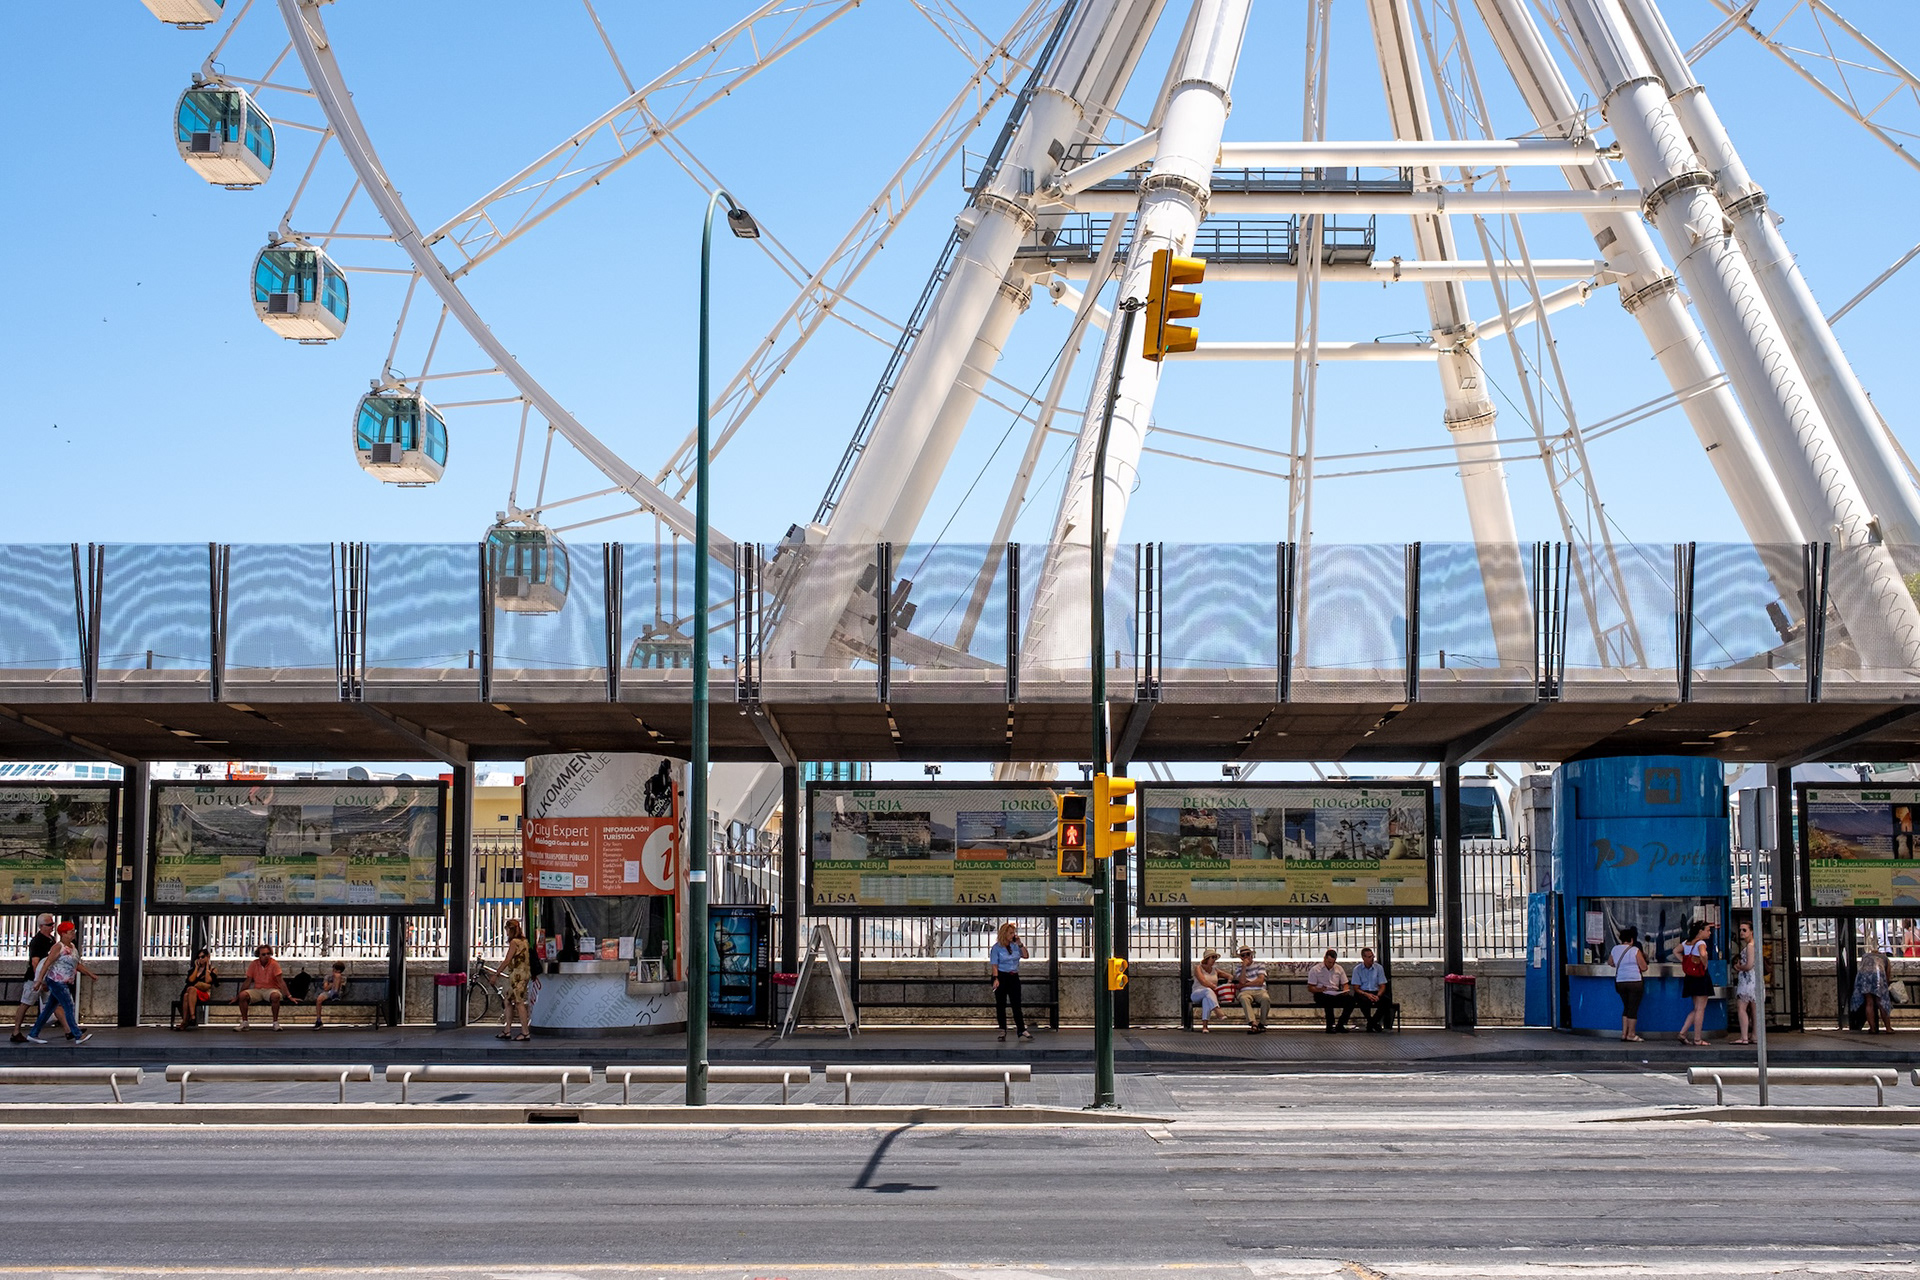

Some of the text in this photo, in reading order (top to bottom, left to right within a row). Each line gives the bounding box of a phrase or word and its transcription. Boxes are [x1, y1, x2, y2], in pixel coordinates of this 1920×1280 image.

[559, 753, 612, 809] BIENVENUE
[856, 799, 902, 812] NERJA
[1182, 796, 1249, 808] PERIANA
[1312, 798, 1392, 809] RIOGORDO
[534, 823, 590, 839] City Expert
[603, 825, 650, 833] INFORMACIÓN
[534, 836, 556, 847] Málaga
[256, 856, 286, 865] M-162
[348, 856, 378, 865] M-360
[569, 853, 589, 862] PÚBLICO
[815, 860, 853, 869] MÁLAGA
[860, 862, 887, 870] NERJA
[955, 860, 993, 869] MÁLAGA
[1145, 860, 1183, 869] MÁLAGA
[1286, 860, 1323, 869] MÁLAGA
[1809, 859, 1838, 867] M-113
[815, 893, 858, 904] ALSA
[956, 893, 998, 904] ALSA
[1147, 892, 1189, 903] ALSA
[1289, 893, 1330, 903] ALSA
